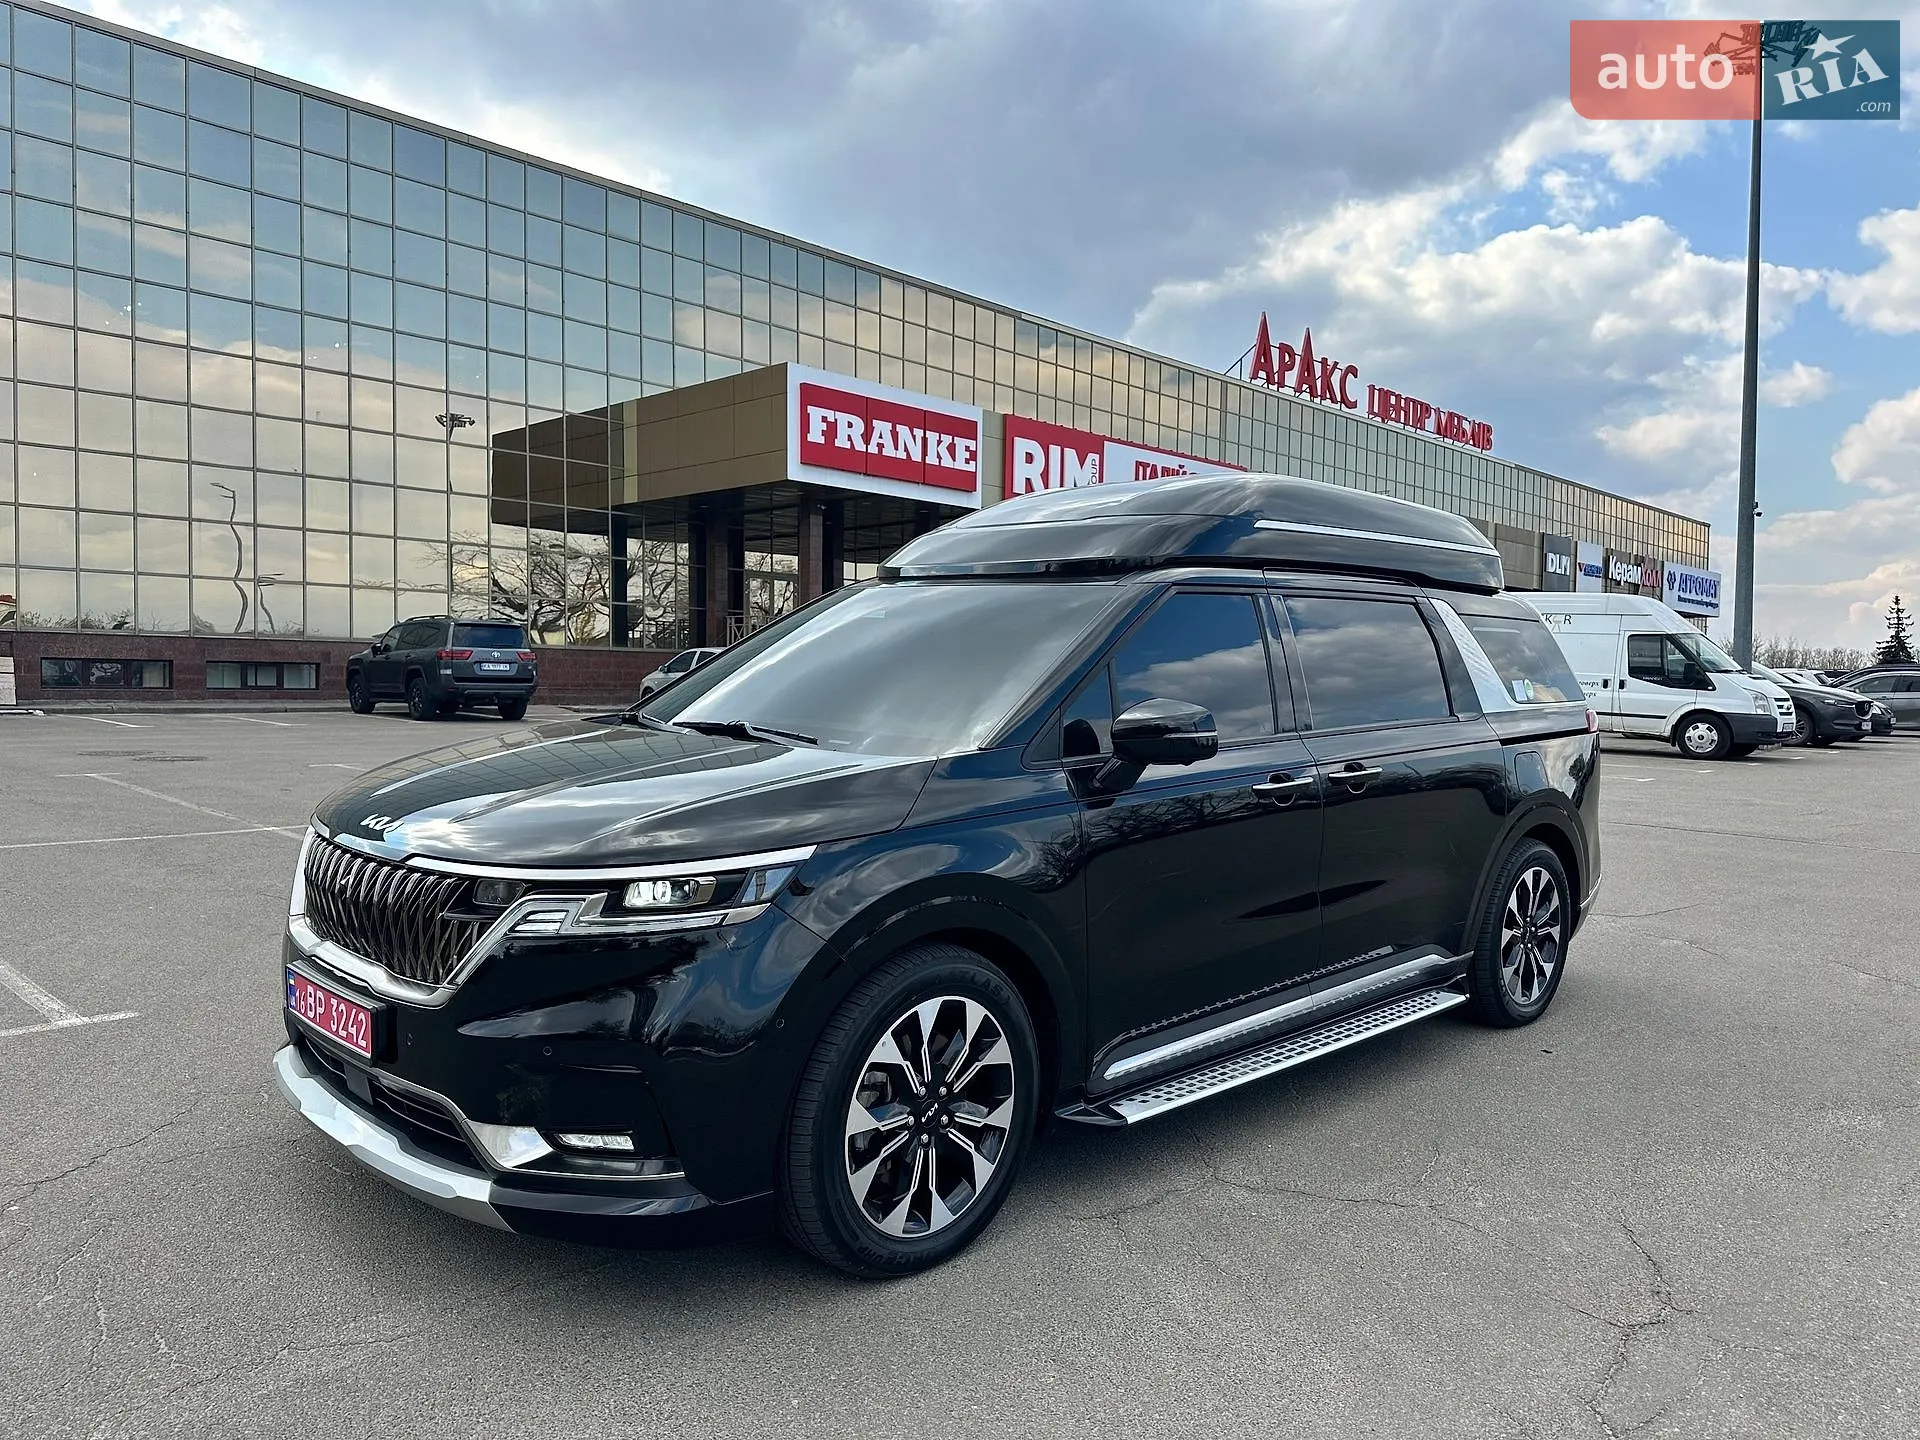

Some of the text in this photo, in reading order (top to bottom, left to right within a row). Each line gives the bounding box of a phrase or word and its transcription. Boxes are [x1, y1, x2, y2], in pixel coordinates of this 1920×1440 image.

[1367, 384, 1431, 430] ЦЕНТР
[807, 405, 977, 473] FRANKE
[1013, 437, 1099, 494] RIM
[1545, 552, 1571, 576] DLM
[330, 997, 367, 1048] 3242
